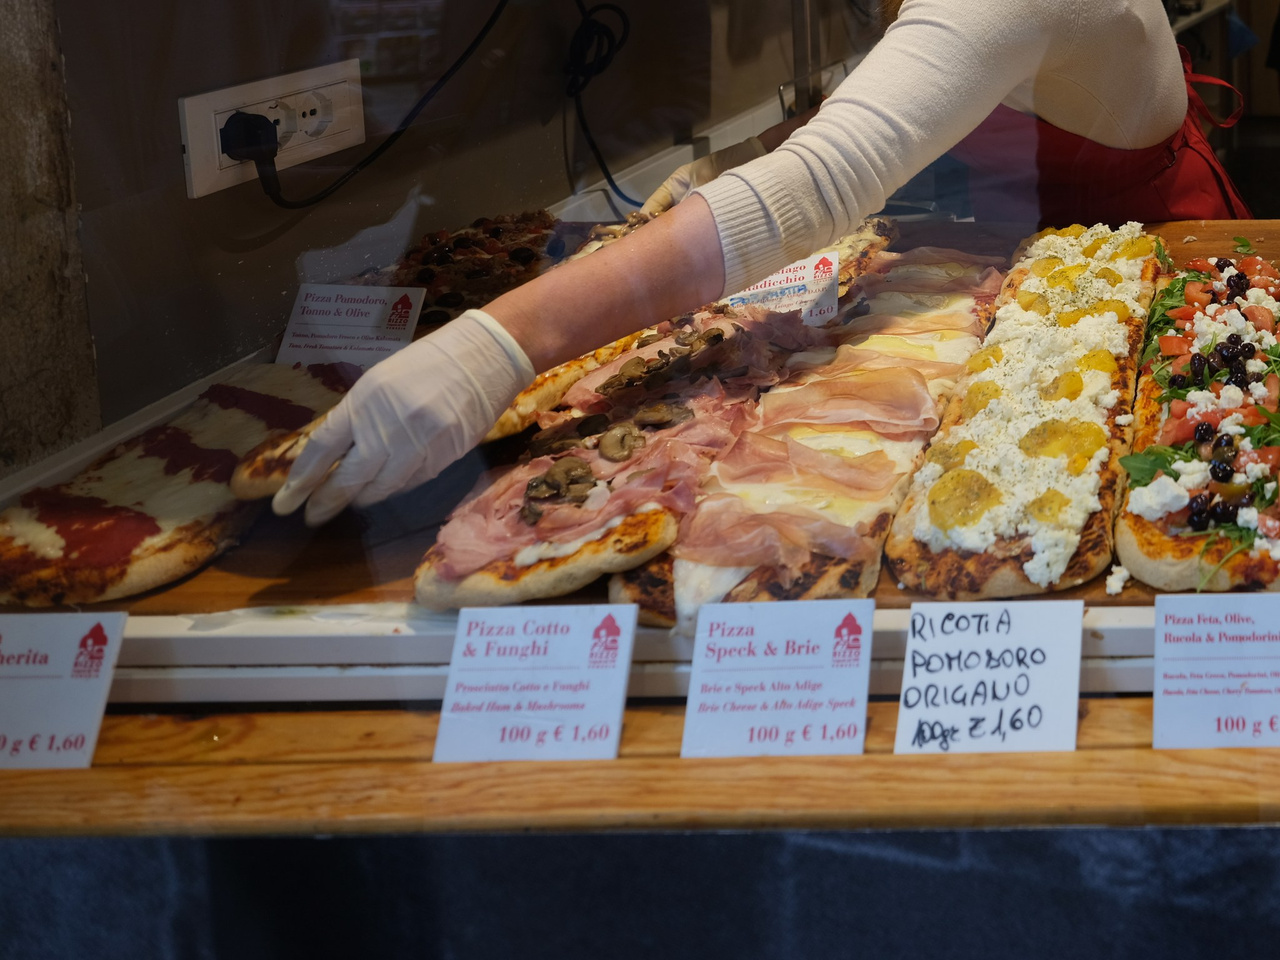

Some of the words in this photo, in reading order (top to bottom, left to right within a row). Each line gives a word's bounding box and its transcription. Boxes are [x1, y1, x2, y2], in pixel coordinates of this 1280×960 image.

[743, 276, 805, 291] adicchio
[304, 293, 331, 303] Pizza
[334, 294, 387, 306] Pomodoro,
[300, 306, 331, 316] Tonno
[334, 307, 342, 317] &
[346, 308, 370, 318] Olive
[1164, 614, 1194, 625] Pizza
[1197, 613, 1222, 625] Feta,
[1225, 613, 1255, 624] Olive,
[467, 621, 515, 637] Pizza
[523, 620, 570, 636] Cotto
[709, 622, 754, 637] Pizza
[1164, 632, 1202, 643] Rucola
[1206, 632, 1214, 642] &
[0, 649, 48, 666] herita
[463, 643, 476, 657] &
[485, 640, 548, 660] Funghi
[705, 642, 756, 662] Speck
[764, 642, 777, 656] &
[785, 640, 820, 655] Brie
[912, 647, 1046, 678] POMODORO
[455, 682, 510, 692] Prosciutto
[513, 682, 540, 691] Cotto
[552, 680, 590, 692] Funghi
[701, 683, 722, 694] Brie
[735, 682, 765, 695] Speck
[771, 682, 790, 691] Alto
[794, 681, 822, 694] Adige
[904, 673, 1030, 708] ORIGANO
[451, 702, 483, 712] Baked
[526, 701, 585, 710] Mushrooms
[698, 703, 719, 713] Brie
[722, 702, 756, 712] Cheese
[760, 702, 768, 710] &
[772, 700, 792, 710] Alto
[796, 701, 823, 712] Adige
[827, 698, 855, 710] Speck
[991, 704, 1042, 742] 1,60
[1215, 716, 1245, 733] 100
[1253, 721, 1262, 737] g
[1269, 715, 1278, 732] €
[500, 726, 530, 743] 100
[535, 730, 547, 746] g
[554, 725, 564, 741] €
[572, 725, 609, 744] 1,60
[748, 726, 779, 743] 100
[784, 730, 795, 747] g
[802, 725, 812, 740] €
[821, 724, 857, 742] 1,60
[10, 739, 23, 756] g
[28, 733, 41, 751] €
[48, 733, 85, 752] 1,60
